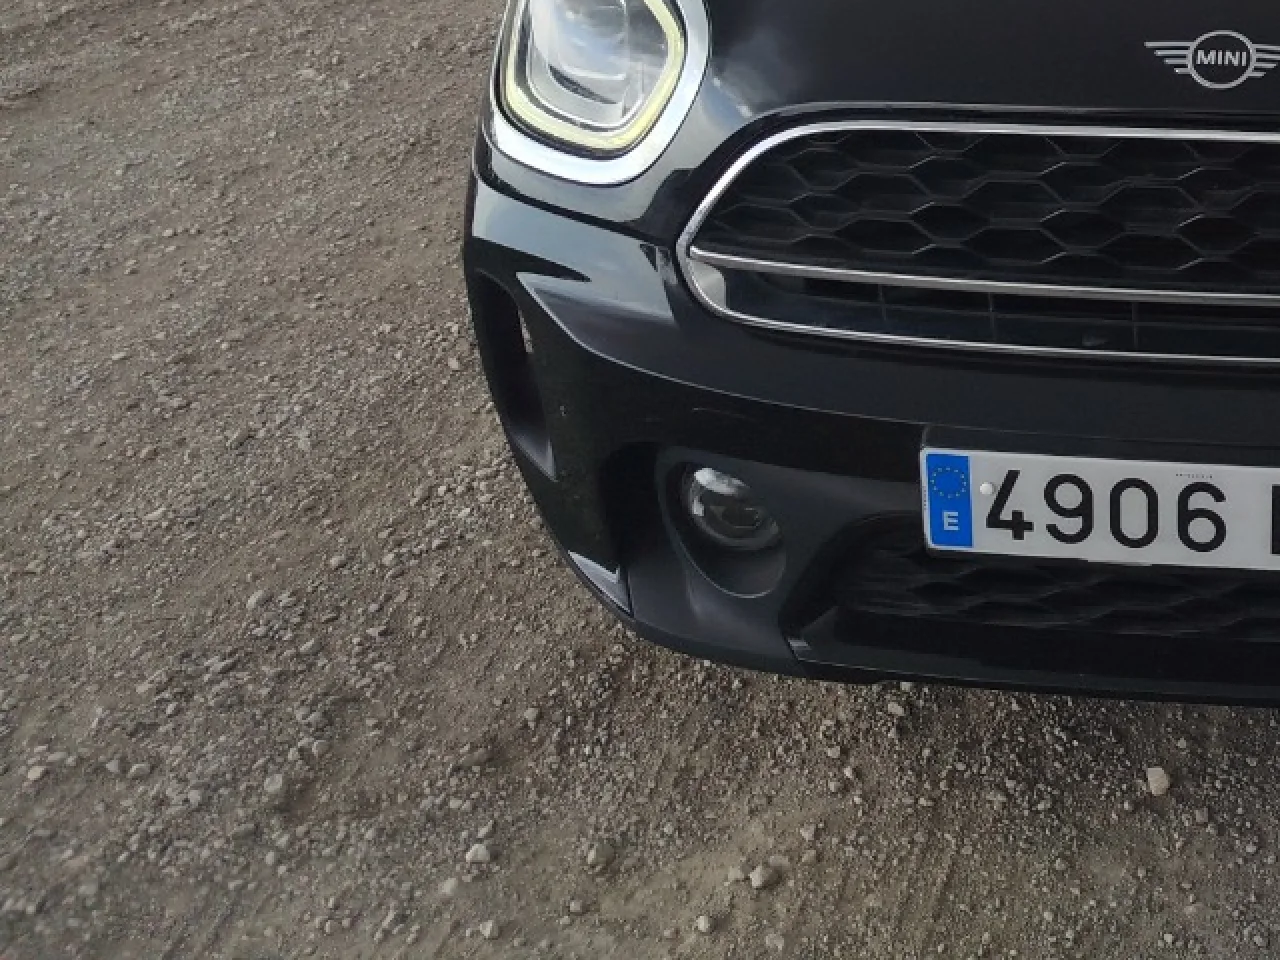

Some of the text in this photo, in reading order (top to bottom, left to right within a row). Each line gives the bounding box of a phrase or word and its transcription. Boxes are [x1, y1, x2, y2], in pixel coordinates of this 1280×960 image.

[1196, 49, 1247, 67] MINI
[942, 509, 960, 531] E
[985, 469, 1227, 553] 4906
